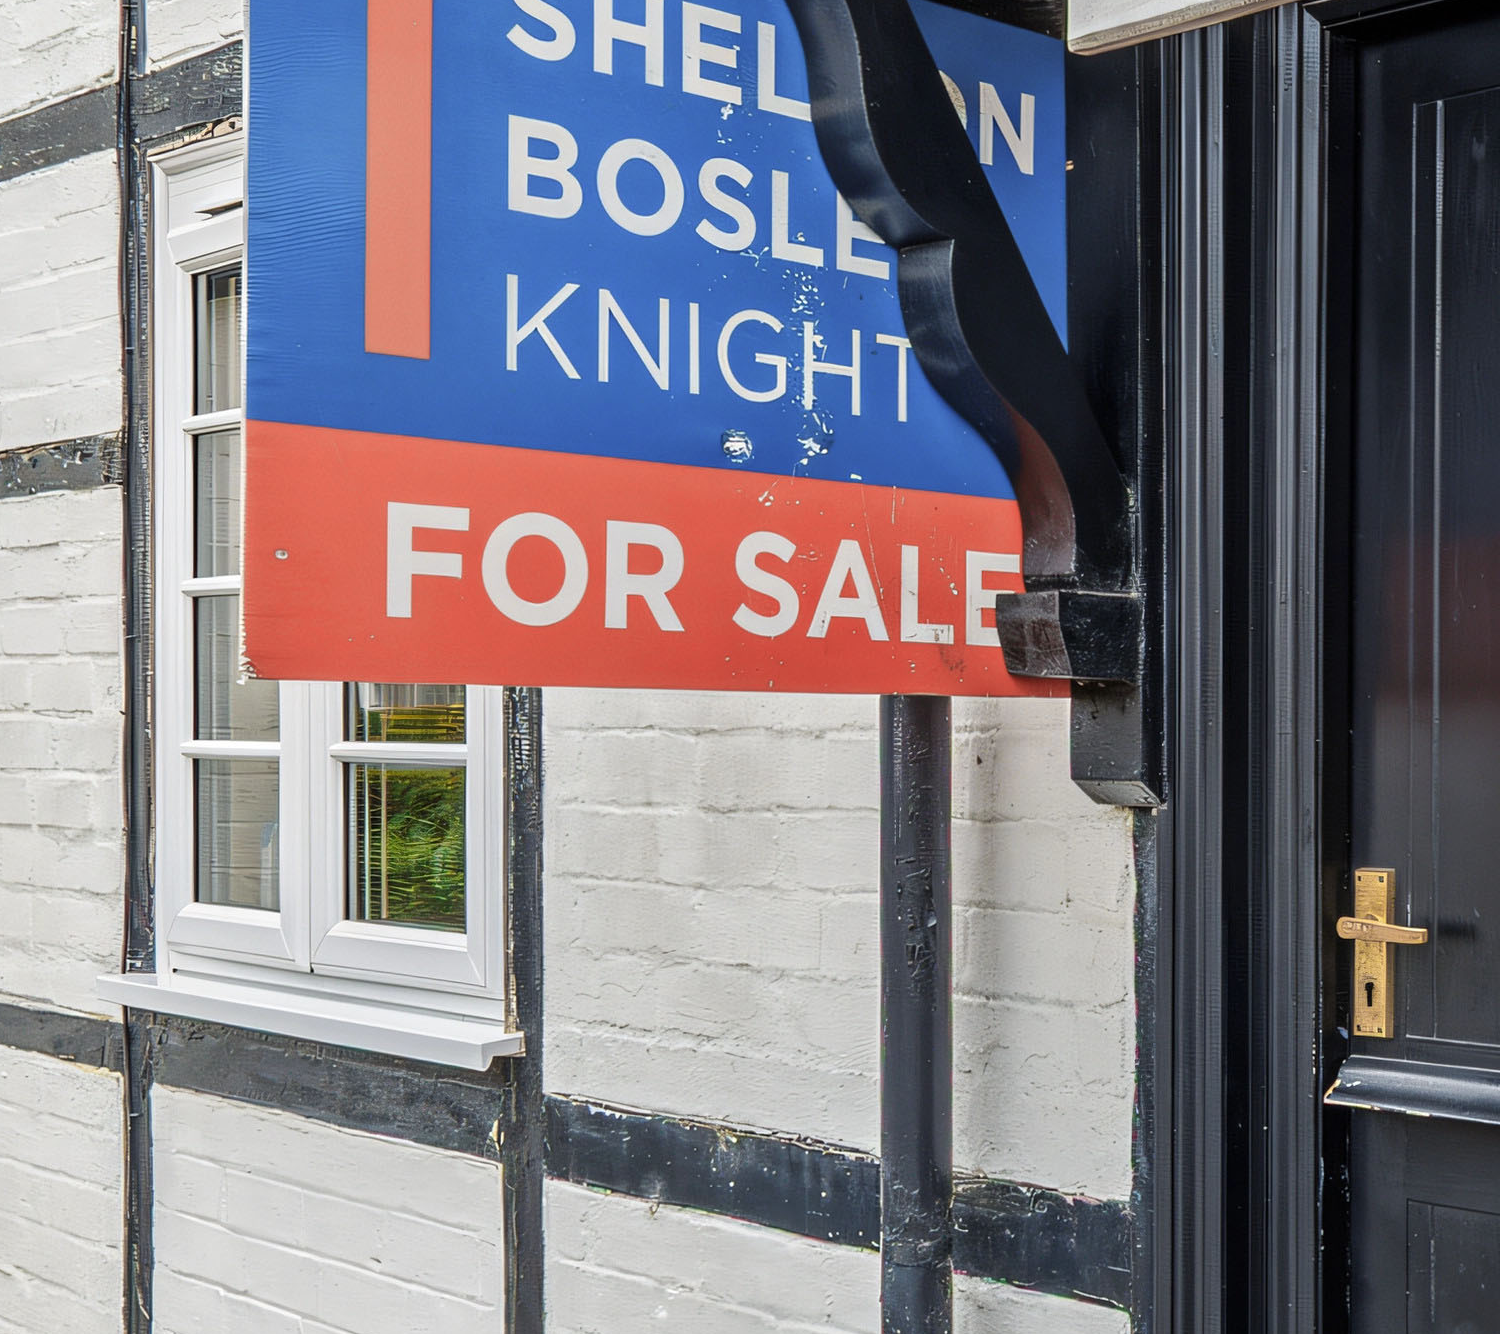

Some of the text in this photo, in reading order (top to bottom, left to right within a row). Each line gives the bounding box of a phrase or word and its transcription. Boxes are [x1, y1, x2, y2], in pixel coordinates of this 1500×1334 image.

[506, 273, 913, 422] KNIGHT
[386, 501, 1020, 647] FOR SALE
